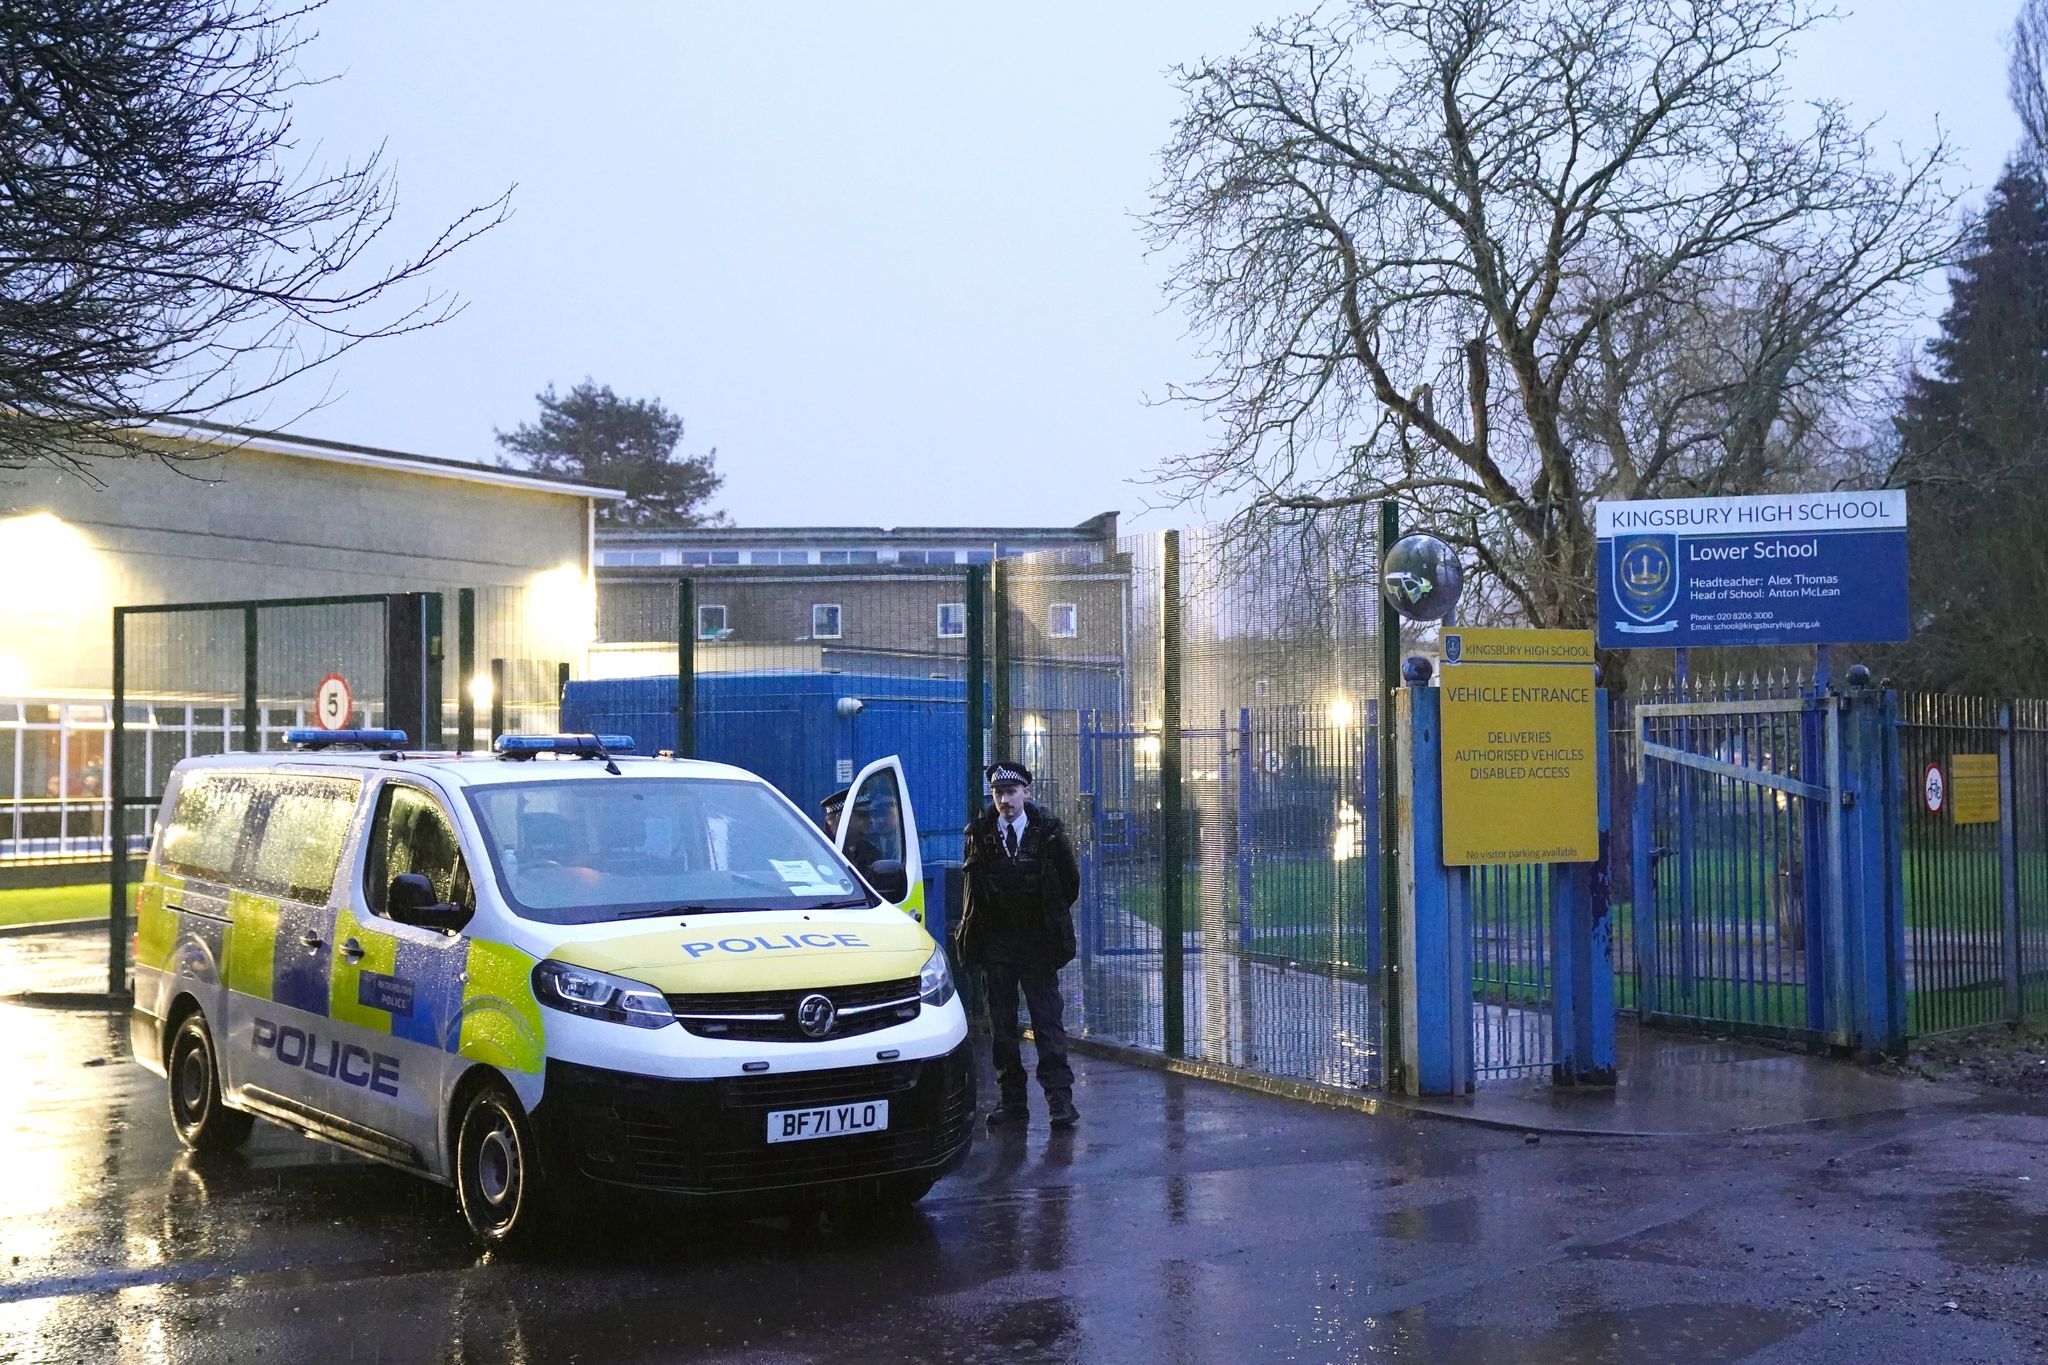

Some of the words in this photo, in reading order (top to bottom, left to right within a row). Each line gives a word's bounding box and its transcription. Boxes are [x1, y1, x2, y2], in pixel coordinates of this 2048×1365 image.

[1612, 506, 1732, 528] KINGSBURY
[1738, 505, 1792, 523] HIGH
[1798, 501, 1890, 521] SCHOOL
[1690, 543, 1749, 561] Lower
[1753, 539, 1817, 559] School
[1690, 575, 1764, 588] Headteacher:
[1768, 575, 1792, 586] Alex
[1794, 574, 1838, 585] Thomas
[1690, 590, 1716, 600] Head
[1717, 589, 1728, 599] of
[1729, 589, 1765, 599] School:
[1768, 588, 1799, 598] Anton
[1801, 587, 1841, 597] McLean
[1690, 613, 1716, 621] Phone:
[1716, 612, 1732, 621] 020
[1753, 611, 1774, 620] 3000
[1690, 622, 1713, 631] Email:
[1465, 644, 1522, 656] KINGSBURY
[1524, 645, 1549, 657] HIGH
[1551, 646, 1590, 657] SCHOOL
[1446, 687, 1509, 702] VEHICLE
[1512, 687, 1589, 703] ENTRANCE
[328, 693, 338, 716] 5
[1488, 731, 1552, 744] DELIVERIES
[1454, 749, 1529, 762] AUTHORISED
[1531, 749, 1584, 761] VEHICLES
[1470, 767, 1526, 780] DISABLED
[1528, 766, 1570, 779] ACCESS
[1466, 850, 1479, 860] No
[1480, 849, 1507, 859] visitor
[1509, 848, 1540, 860] parking
[1541, 847, 1578, 858] available
[681, 933, 870, 958] POLICE
[381, 993, 407, 1009] POLICE
[254, 1018, 400, 1098] POLICE
[782, 1110, 830, 1137] BF71
[837, 1104, 876, 1131] YLO
